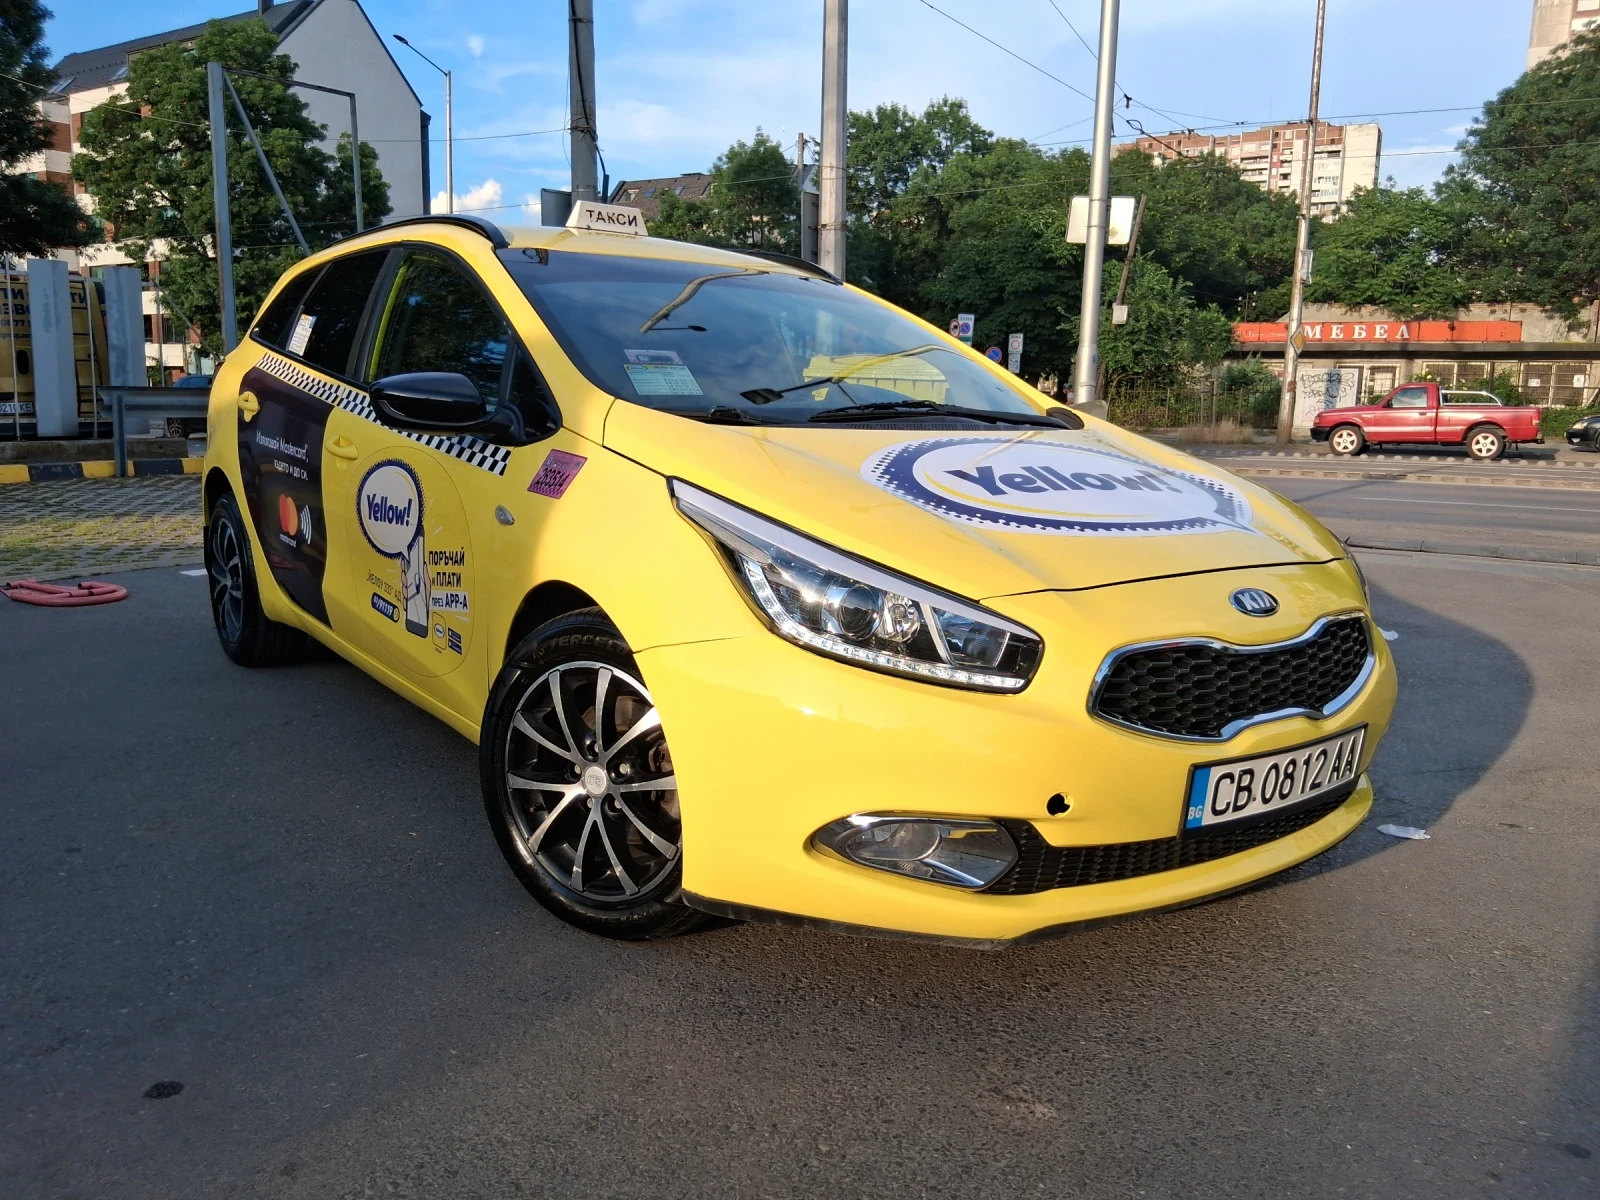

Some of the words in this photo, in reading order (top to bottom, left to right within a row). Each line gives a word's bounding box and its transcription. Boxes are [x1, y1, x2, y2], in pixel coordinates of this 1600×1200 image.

[585, 209, 638, 227] ТАКСИ
[1303, 324, 1410, 339] МЕБЕЛ
[943, 465, 1184, 497] Yellow!
[366, 493, 413, 527] Yellow!
[428, 546, 465, 567] ПОРЪЧАЙ
[436, 571, 462, 588] ПЛАТИ
[431, 597, 444, 607] ПРЕЗ
[1235, 590, 1277, 611] KIA
[1210, 767, 1256, 817] CB
[1259, 747, 1329, 806] 0812
[1325, 735, 1357, 784] AA
[1187, 804, 1203, 821] BG
